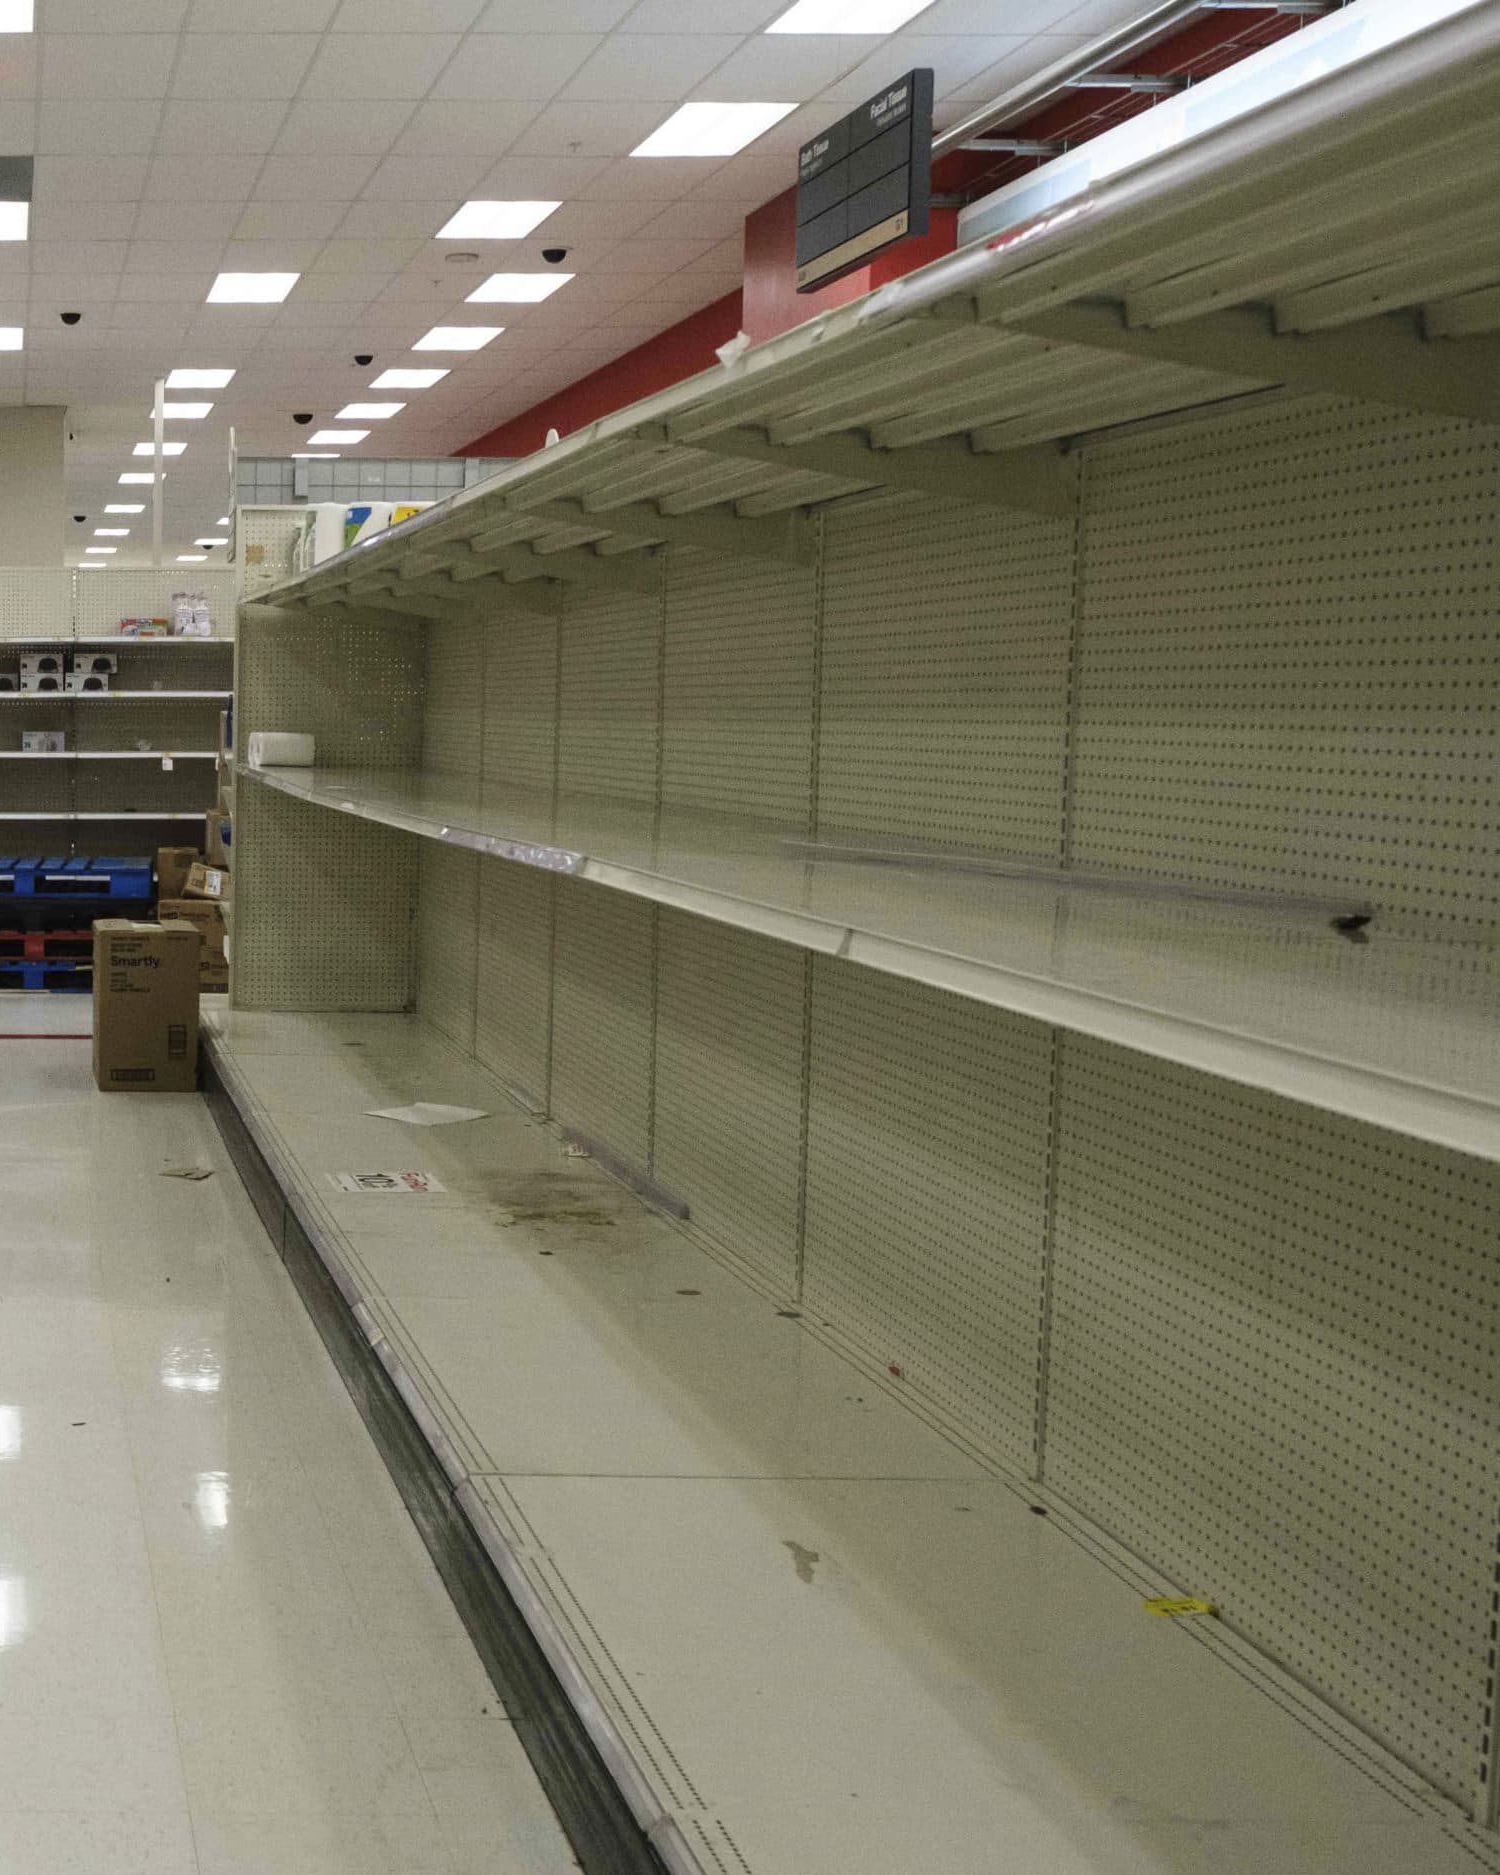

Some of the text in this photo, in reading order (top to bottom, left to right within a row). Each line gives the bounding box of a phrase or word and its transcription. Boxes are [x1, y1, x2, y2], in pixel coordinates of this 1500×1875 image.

[869, 97, 887, 119] Facial
[888, 86, 908, 108] Tissue
[111, 955, 160, 969] Smartly
